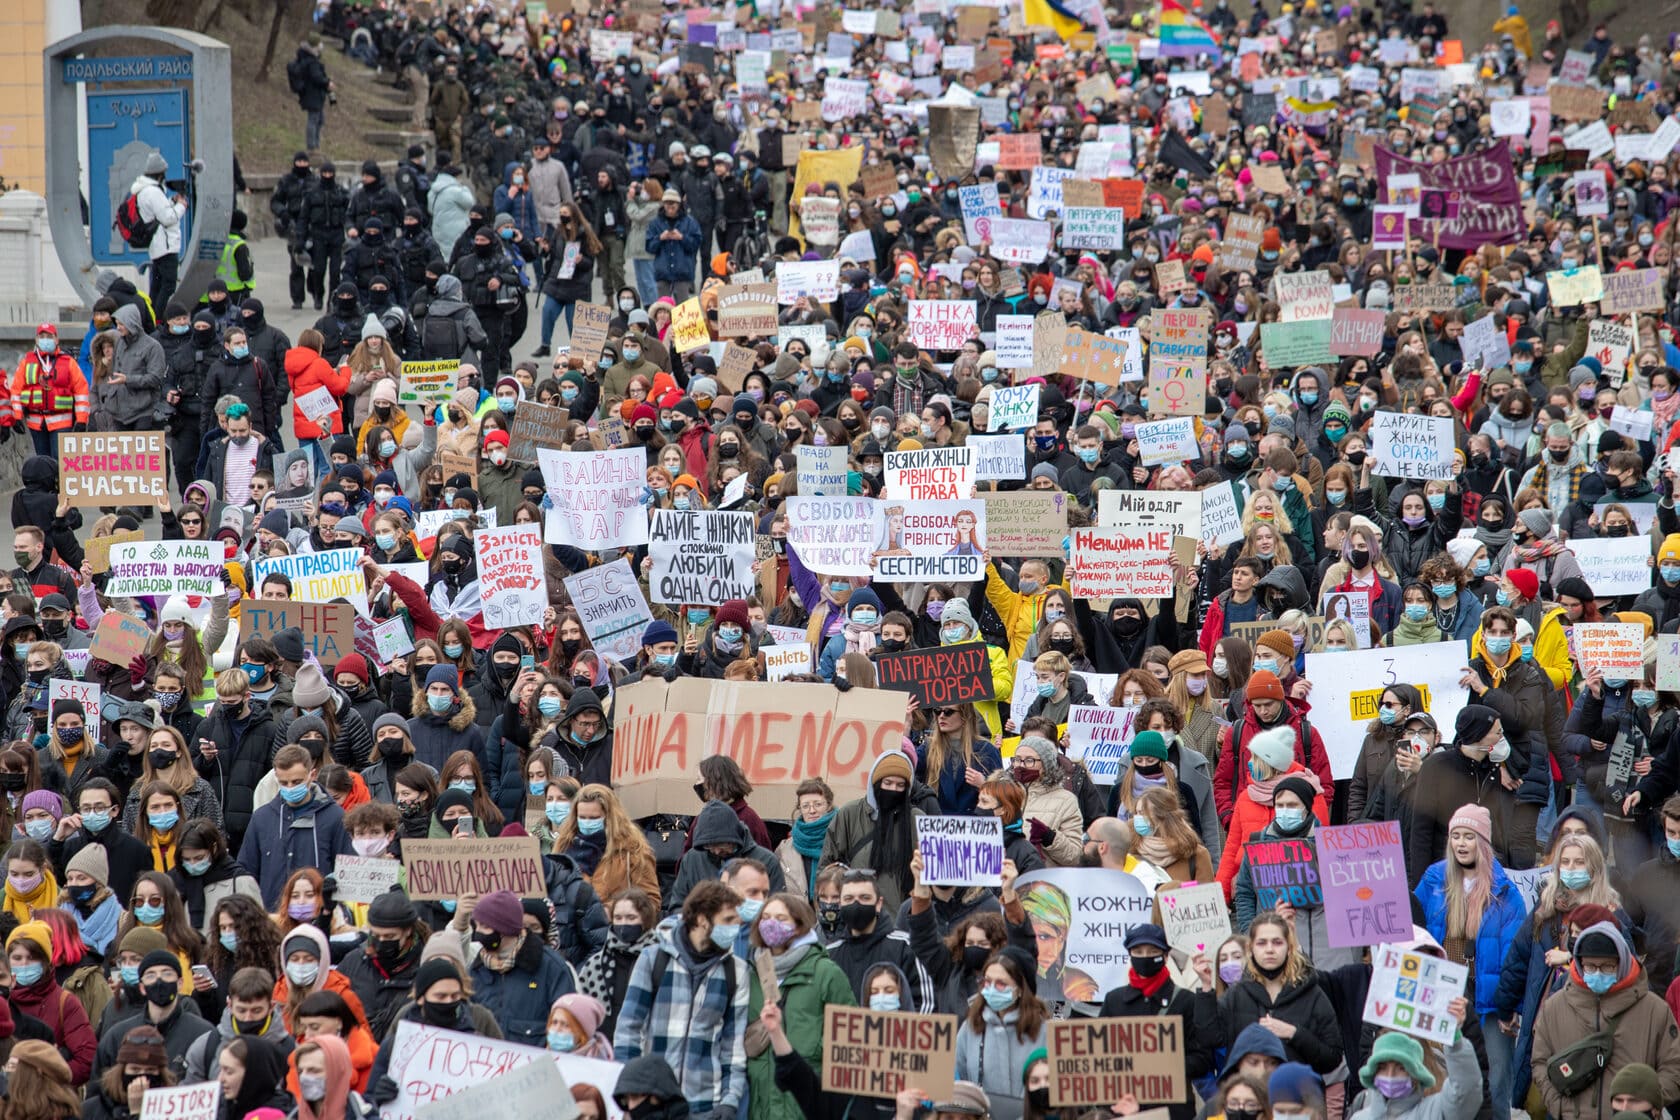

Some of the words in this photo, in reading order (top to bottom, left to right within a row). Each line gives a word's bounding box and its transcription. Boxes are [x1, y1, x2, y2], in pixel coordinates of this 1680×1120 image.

[67, 59, 153, 78] ПОДІЛЬСЬКИЙ
[913, 304, 976, 319] ЖІНКА
[1163, 313, 1197, 327] ПЕРШ
[910, 320, 975, 337] ТОВАРИШКА
[993, 386, 1034, 406] ХОЧУ
[992, 400, 1034, 418] ЖІНКУ
[1379, 416, 1436, 430] ДАРУЙТЕ
[63, 435, 161, 453] ПРОСТОЕ
[1389, 430, 1437, 447] ЖІНКАМ
[800, 447, 832, 458] ПРАВО
[887, 450, 931, 471] ВСЯКІЙ
[931, 447, 971, 467] ЖІНЦІ
[1391, 443, 1440, 462] ОРГАЗМ
[63, 453, 161, 473] ЖЕНСКОЕ
[815, 462, 829, 470] НА
[1379, 461, 1391, 475] А
[1397, 461, 1413, 477] НЕ
[899, 466, 958, 486] РІВНІСТЬ
[962, 465, 966, 482] І
[65, 475, 164, 497] СЧАСТЬЕ
[910, 484, 959, 501] ПРАВА
[1119, 493, 1145, 512] Мій
[652, 510, 700, 543] ДАЙТЕ
[706, 512, 754, 544] ЖІНКАМ
[904, 515, 957, 529] СВОБОДА
[904, 533, 957, 546] РІВНІСТЬ
[1148, 531, 1170, 550] НЕ
[122, 547, 137, 559] ГО
[176, 544, 210, 559] ЛАДА
[120, 562, 168, 578] ДЕКРЕТНА
[296, 551, 340, 577] ПРАВО
[343, 549, 361, 571] НА
[669, 554, 735, 580] ЛЮБИТИ
[879, 555, 978, 576] СЕСТРИНСТВО
[177, 580, 213, 594] ПРАЦЯ
[309, 573, 365, 600] ПОЛОГИ
[661, 577, 701, 600] ОДНА
[708, 579, 752, 602] ОДНУ
[583, 594, 637, 623] ЗНАЧИТЬ
[247, 608, 286, 631] ТИ
[300, 604, 338, 634] НЕ
[879, 647, 986, 684] ПАТРІАРХАТУ
[60, 684, 90, 700] SEX
[917, 675, 988, 703] ТОРБА
[633, 712, 688, 775] UNA
[918, 817, 998, 836] СЕКСИЗМ-КРІНЖ
[1321, 822, 1400, 851] RESISTING
[1245, 840, 1313, 866] РІВНІСТЬ
[1252, 862, 1318, 887] ГІДНІСТЬ
[1328, 857, 1396, 887] BITCH
[1077, 896, 1154, 912] КОЖНА
[1169, 896, 1219, 923] КИШЕНІ
[1345, 901, 1405, 938] FACE
[1083, 922, 1136, 938] ЖІНК
[831, 1010, 952, 1051] FEMINISM
[1054, 1022, 1177, 1057] FEMINISM
[830, 1044, 883, 1067] DOESN'T
[889, 1051, 928, 1073] MEAN
[1057, 1059, 1090, 1075] DOES
[1093, 1055, 1133, 1073] MEAN
[829, 1067, 867, 1090] ANTI
[870, 1070, 906, 1092] MEN
[1058, 1078, 1098, 1102] PRO
[1103, 1074, 1174, 1101] HUMAN
[145, 1091, 215, 1115] HISTORY
